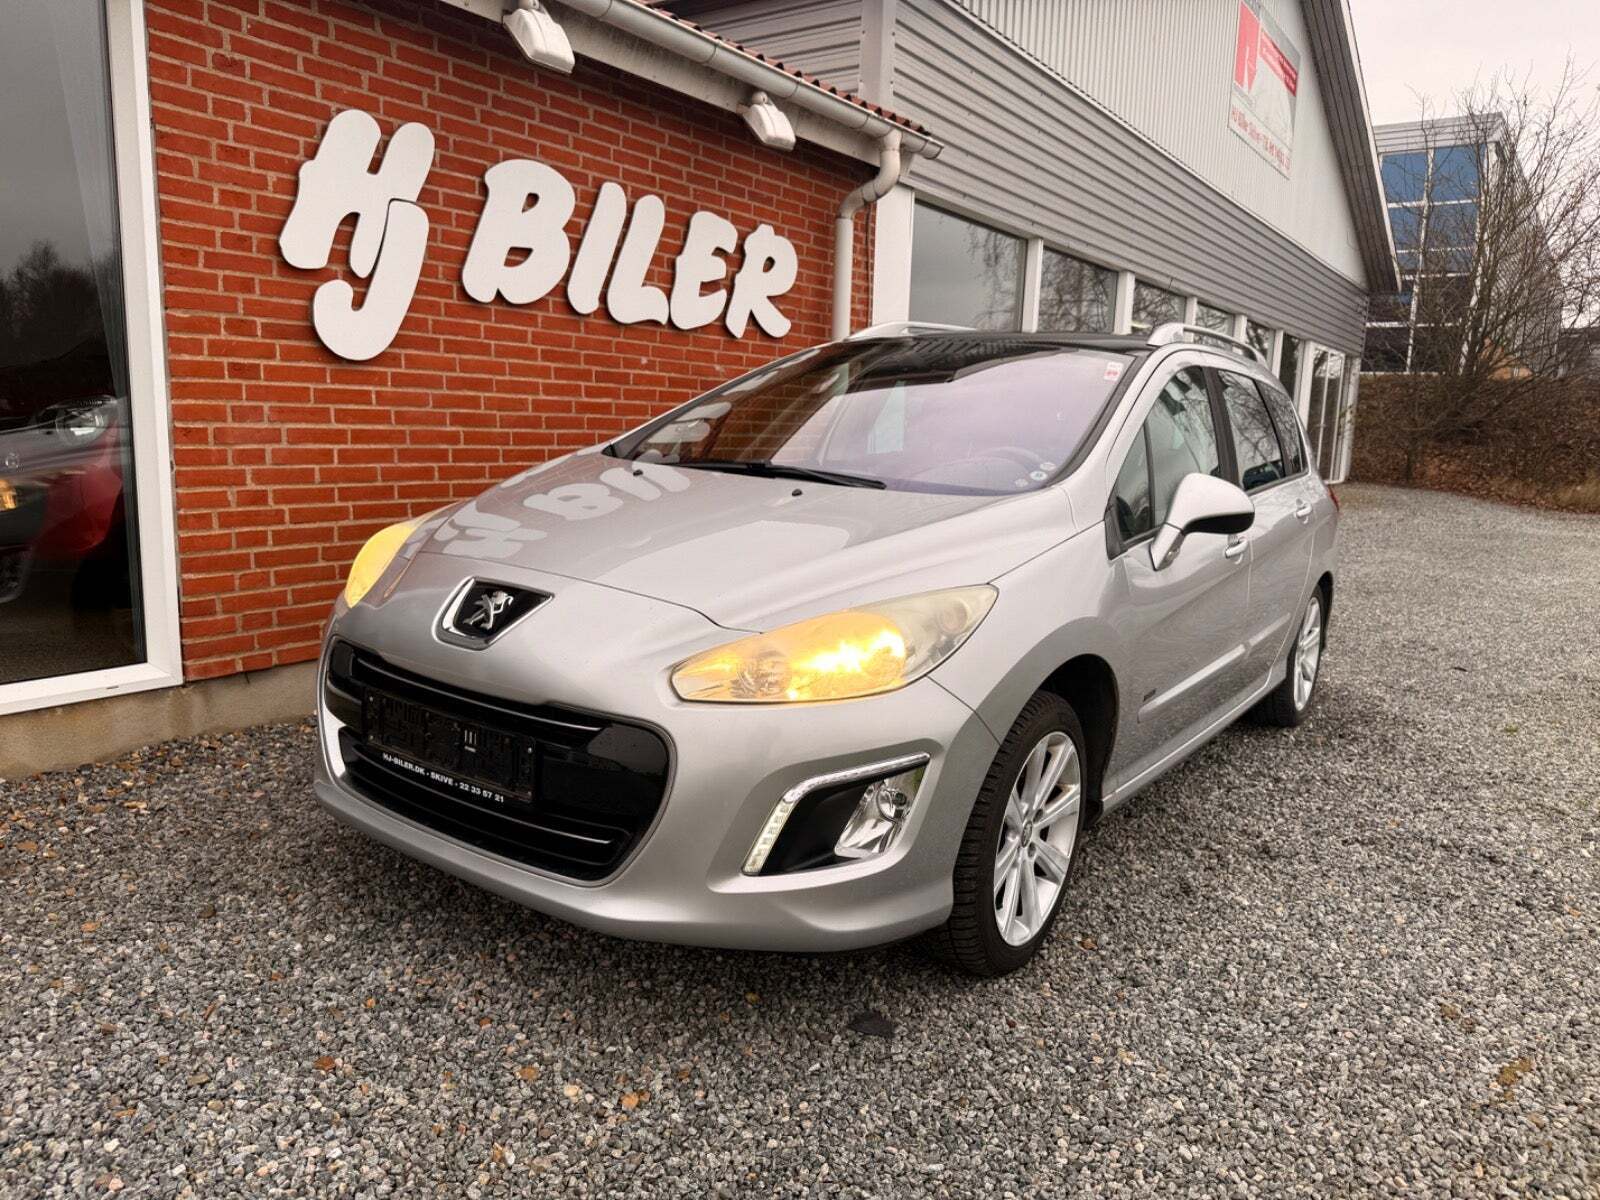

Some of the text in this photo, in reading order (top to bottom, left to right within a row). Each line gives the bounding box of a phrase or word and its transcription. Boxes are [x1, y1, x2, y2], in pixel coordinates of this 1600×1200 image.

[279, 108, 798, 361] HJ BILER
[382, 752, 426, 776] HJ-BILER.DK
[430, 771, 454, 786] SKIVE
[459, 782, 470, 791] 22
[471, 785, 481, 795] 33
[494, 793, 504, 803] 21
